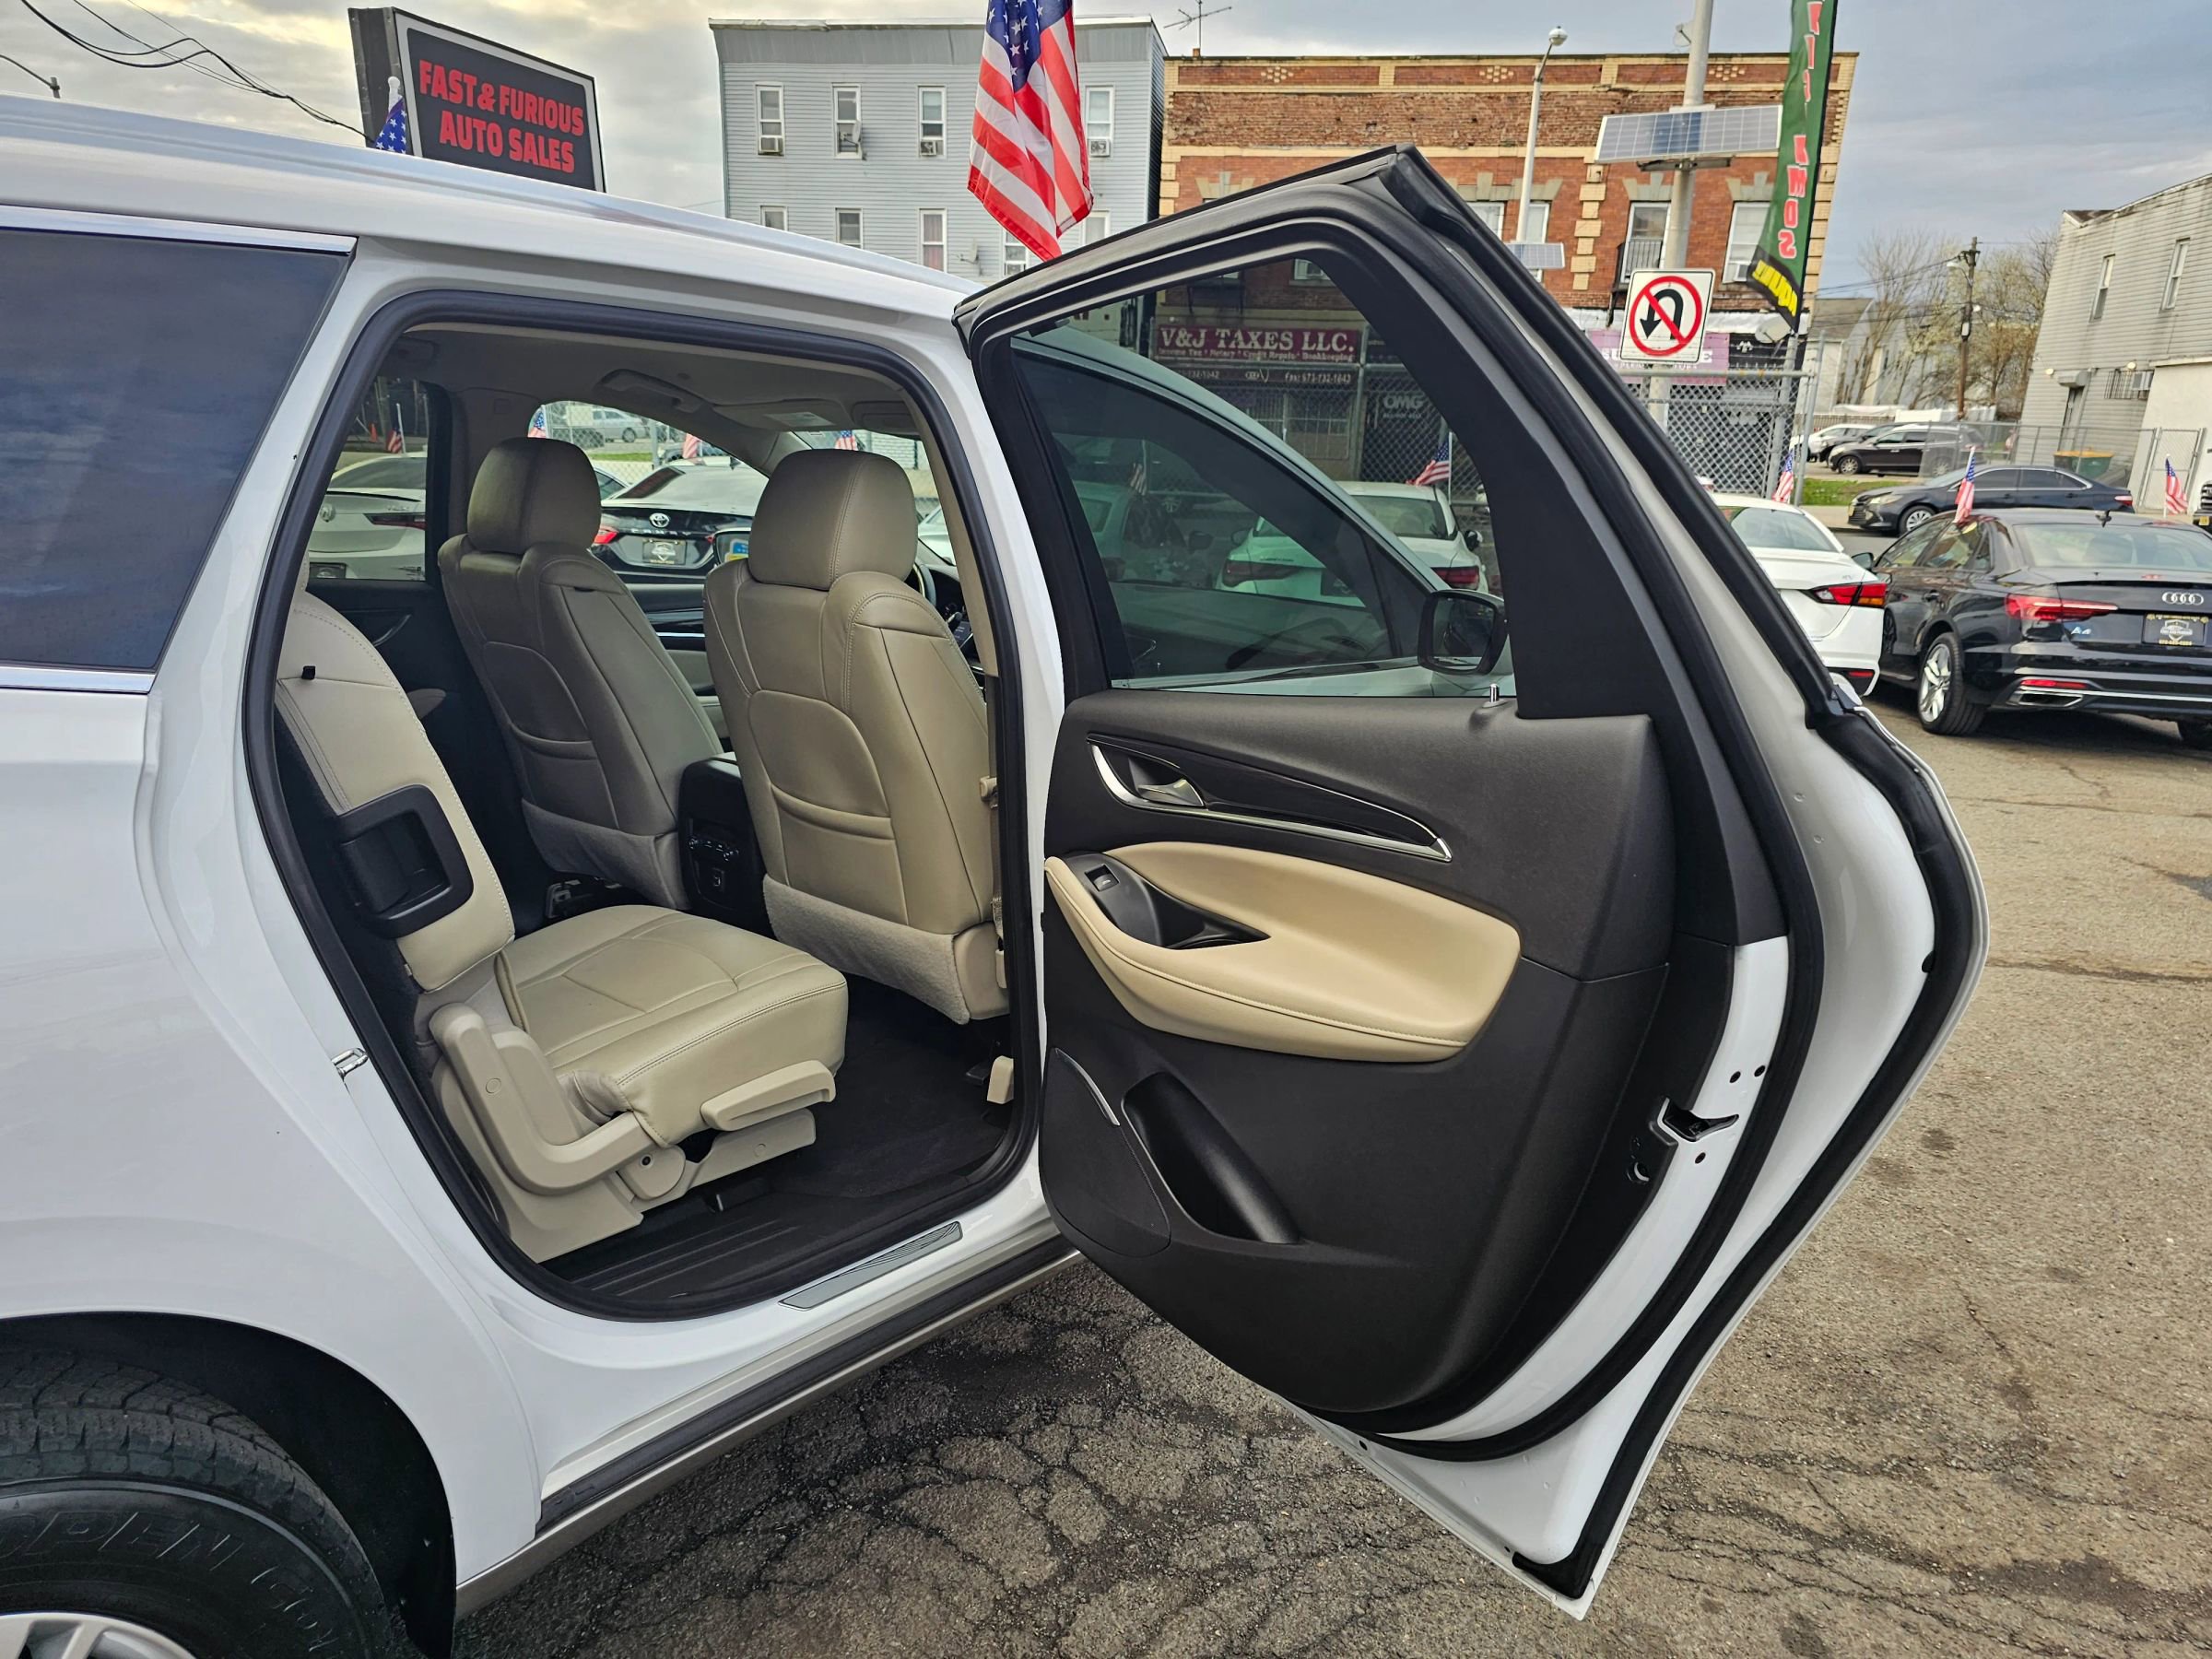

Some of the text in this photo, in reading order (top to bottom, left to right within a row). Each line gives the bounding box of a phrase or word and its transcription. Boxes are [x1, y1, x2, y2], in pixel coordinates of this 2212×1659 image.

[419, 59, 583, 135] FAST & FURIOUS
[439, 111, 575, 174] AUTO SALES
[1160, 327, 1355, 352] V&J TAXES LLC.
[2070, 626, 2092, 635] A4
